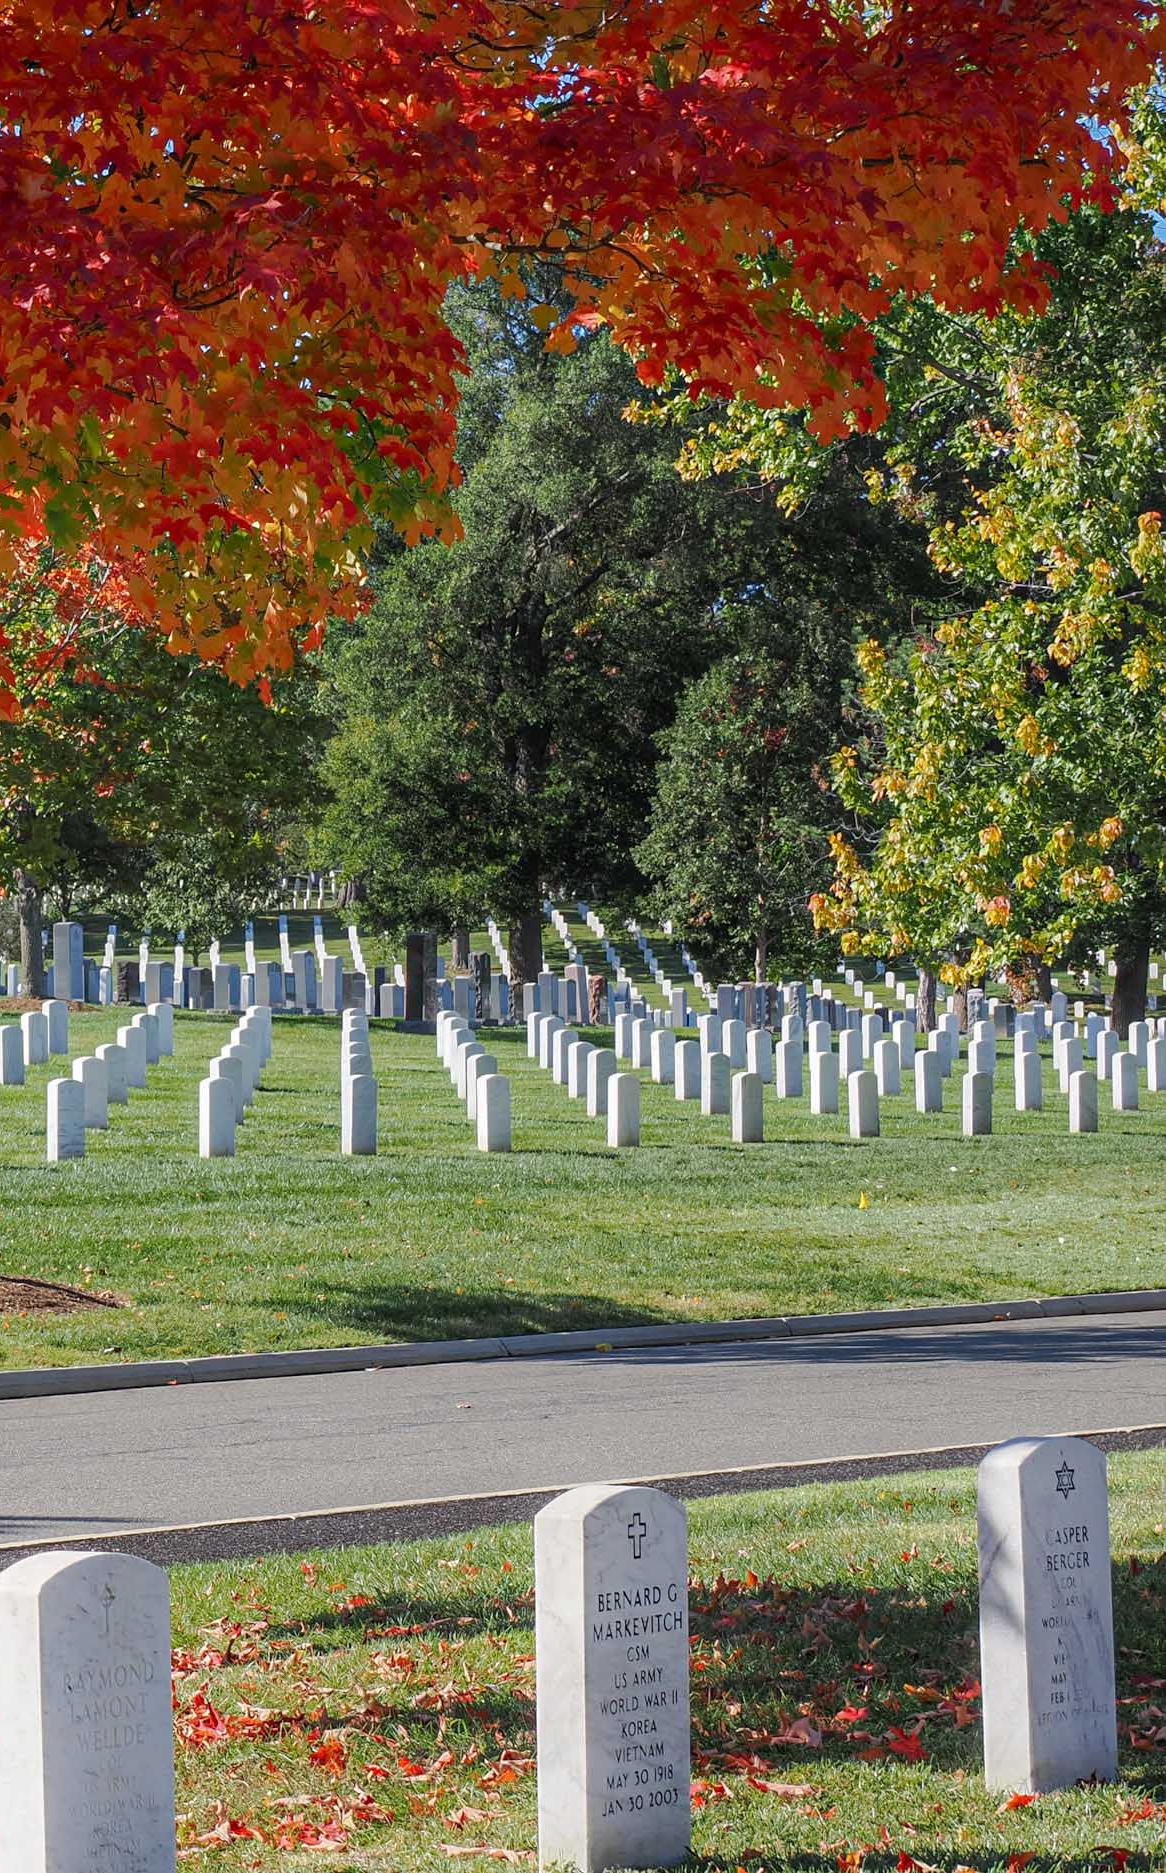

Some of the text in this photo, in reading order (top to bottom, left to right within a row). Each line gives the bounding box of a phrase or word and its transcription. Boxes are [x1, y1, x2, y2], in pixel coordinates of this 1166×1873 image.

[1046, 1526, 1089, 1546] CASPER
[1046, 1552, 1090, 1572] BERGER
[597, 1583, 678, 1613] BERNARD G
[593, 1611, 683, 1642] MARKEVITCH
[626, 1645, 650, 1662] CSM
[64, 1660, 154, 1694] RAYMOND
[614, 1667, 663, 1689] US ARMY
[67, 1691, 147, 1723] LAMONT
[600, 1696, 639, 1716] WORLD
[644, 1691, 667, 1709] WAR
[621, 1719, 657, 1739] KOREA
[615, 1742, 665, 1763] VIETNAM
[606, 1764, 674, 1791] MAY 30 1918
[602, 1788, 679, 1817] JAN 30 2003
